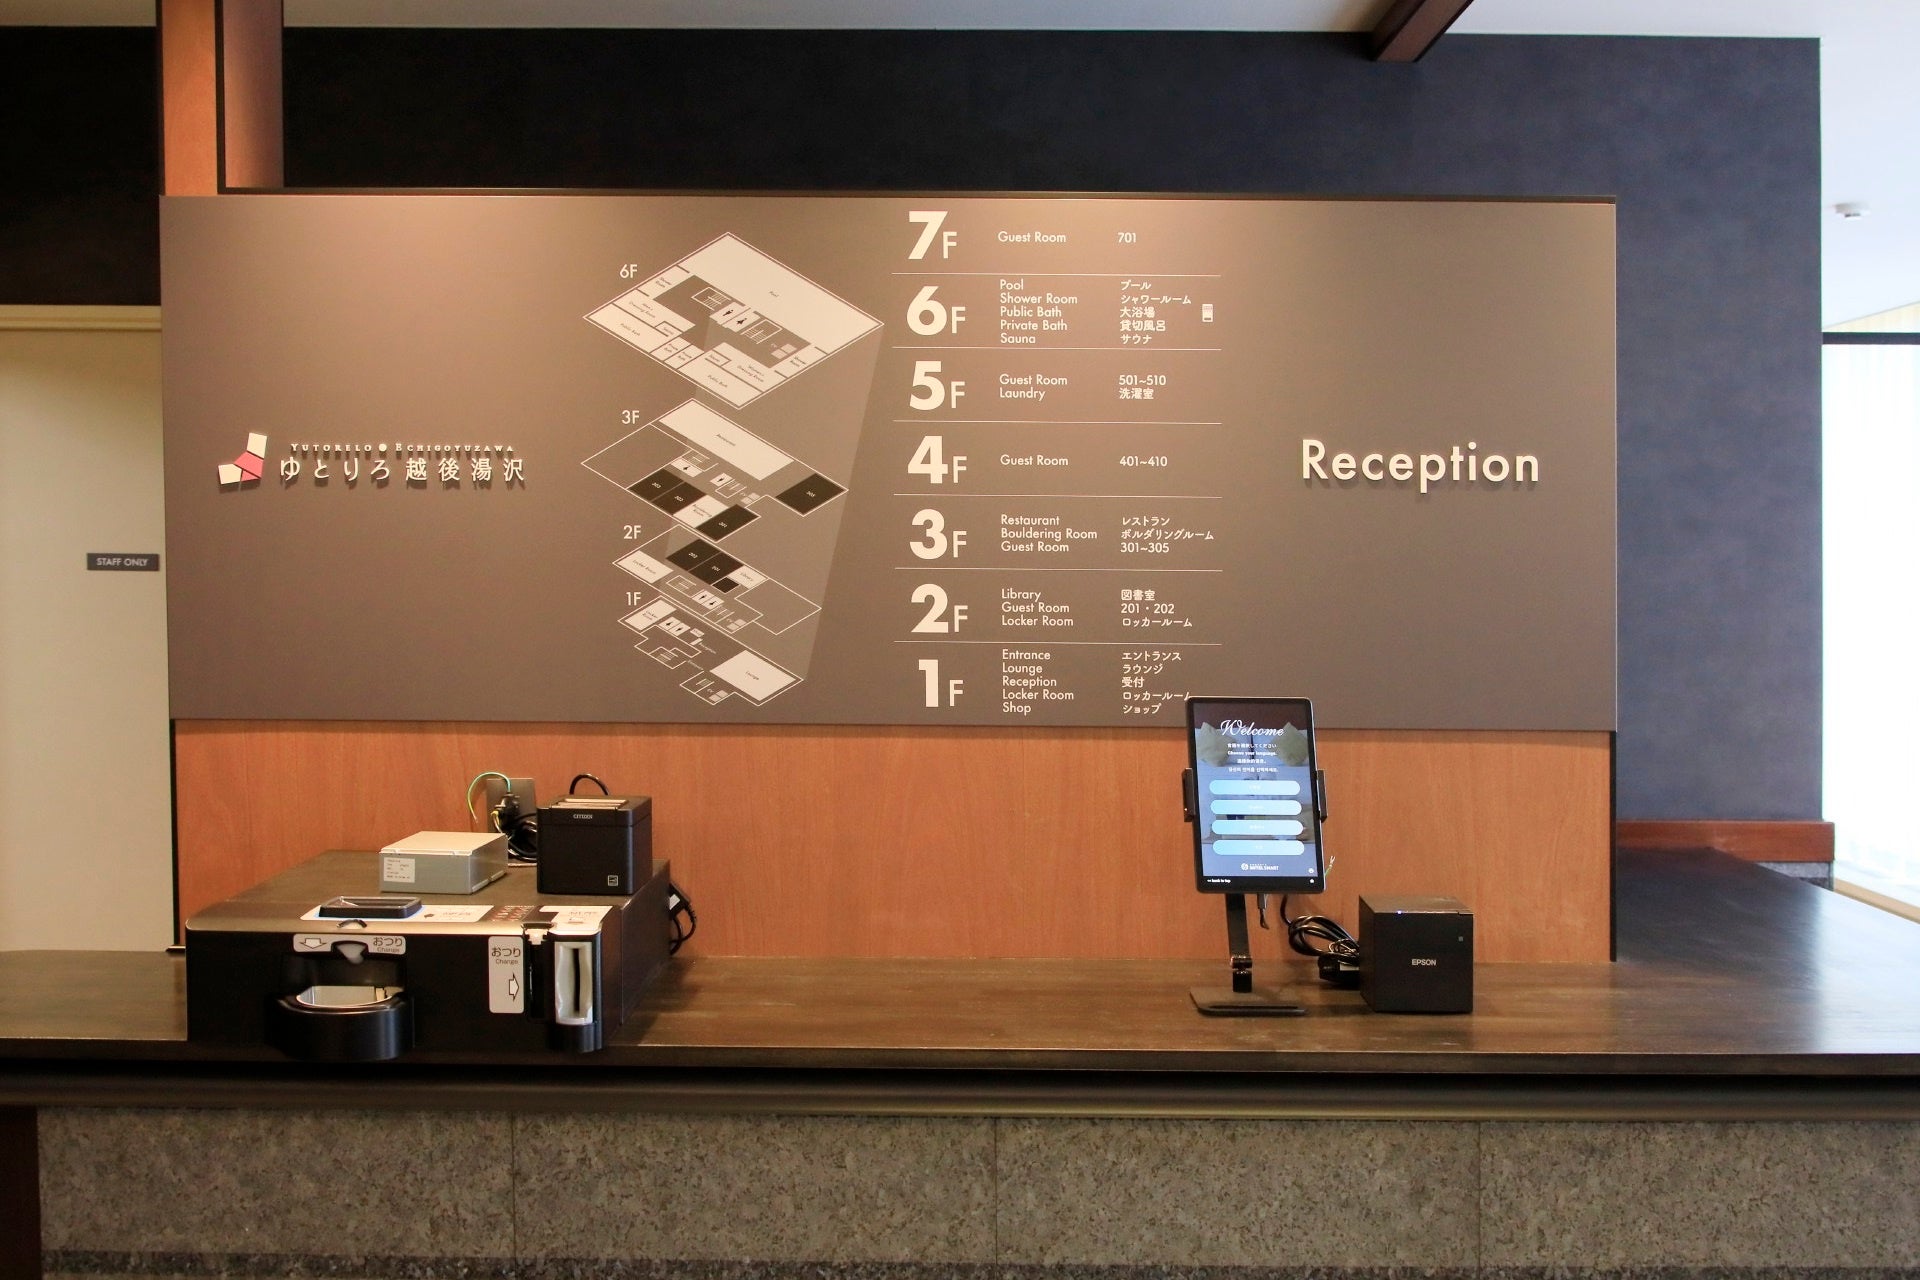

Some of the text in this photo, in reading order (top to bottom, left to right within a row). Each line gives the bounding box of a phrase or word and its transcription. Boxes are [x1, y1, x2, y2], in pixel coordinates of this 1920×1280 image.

[909, 211, 957, 259] 7F
[998, 231, 1066, 242] Guest Room
[1118, 232, 1136, 243] 701
[620, 264, 637, 278] 6F
[1000, 279, 1023, 290] Pool
[1121, 280, 1151, 290] プール
[1000, 292, 1077, 304] Shower Room
[1121, 295, 1191, 304] シャワールーム
[907, 286, 965, 335] 6F
[1001, 305, 1061, 317] Public Bath
[1120, 306, 1155, 318] 大浴場
[1001, 319, 1067, 330] Private Bath
[1120, 319, 1165, 331] 貸切風呂
[1001, 333, 1035, 343] Sauna
[1120, 334, 1151, 344] サウナ
[1000, 374, 1067, 385] Guest Room
[910, 361, 965, 410] 5F
[1000, 388, 1045, 401] Laundry
[1119, 387, 1153, 399] 洗濯室
[622, 410, 639, 424] 3F
[908, 436, 967, 483] 4F
[1000, 454, 1068, 465] Guest Room
[281, 457, 524, 481] ゆとりろ越後湯沢
[1303, 439, 1538, 493] Reception
[1001, 514, 1059, 525] Restaurant
[1123, 516, 1169, 526] レストラン
[624, 525, 641, 539] 2F
[910, 509, 966, 559] 3F
[1001, 527, 1097, 541] Bouldering Room
[1121, 528, 1213, 540] ボルダリングルーム
[1001, 540, 1069, 551] Guest Room
[124, 558, 147, 566] ONLY
[626, 592, 641, 606] 1F
[1002, 588, 1041, 602] Library
[1121, 590, 1155, 600] 図書室
[911, 584, 968, 633] 2F
[1002, 602, 1069, 613] Guest Room
[1002, 615, 1073, 626] Locker Room
[1123, 617, 1192, 627] ロッカールーム
[1003, 649, 1050, 659] Entrance
[1122, 651, 1181, 661] エントランス
[1003, 662, 1042, 675] Lounge
[1123, 663, 1163, 674] ラウンジ
[919, 659, 963, 707] 1F
[1003, 676, 1056, 688] Reception
[1122, 677, 1144, 687] 受付
[1003, 688, 1073, 699] Locker Room
[1003, 702, 1031, 714] Shop
[1123, 703, 1161, 714] ショップ
[1220, 719, 1285, 736] Welcome
[373, 937, 403, 947] おつり
[491, 946, 521, 957] おつり
[1411, 958, 1437, 966] EPSON
